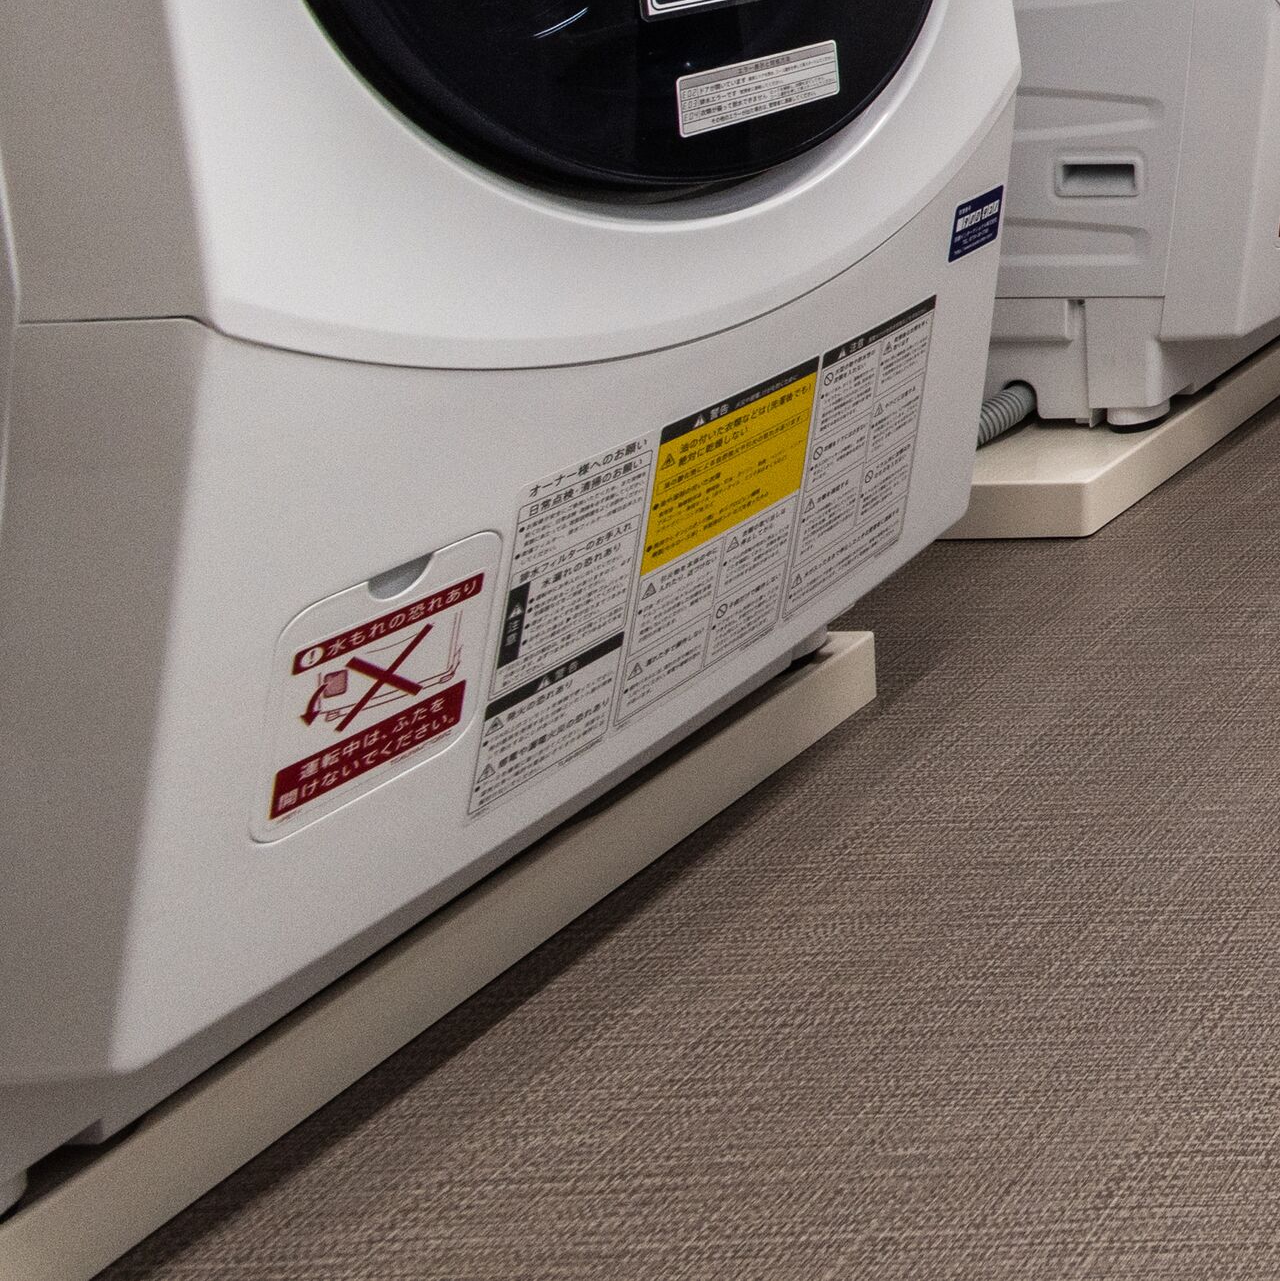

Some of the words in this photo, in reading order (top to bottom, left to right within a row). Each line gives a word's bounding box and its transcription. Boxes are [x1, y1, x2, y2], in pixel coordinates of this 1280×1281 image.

[529, 438, 648, 499] オーナー様へのお願い
[326, 579, 478, 658] 水もれの恐れあり
[298, 695, 447, 783] 運転中は、ふたを
